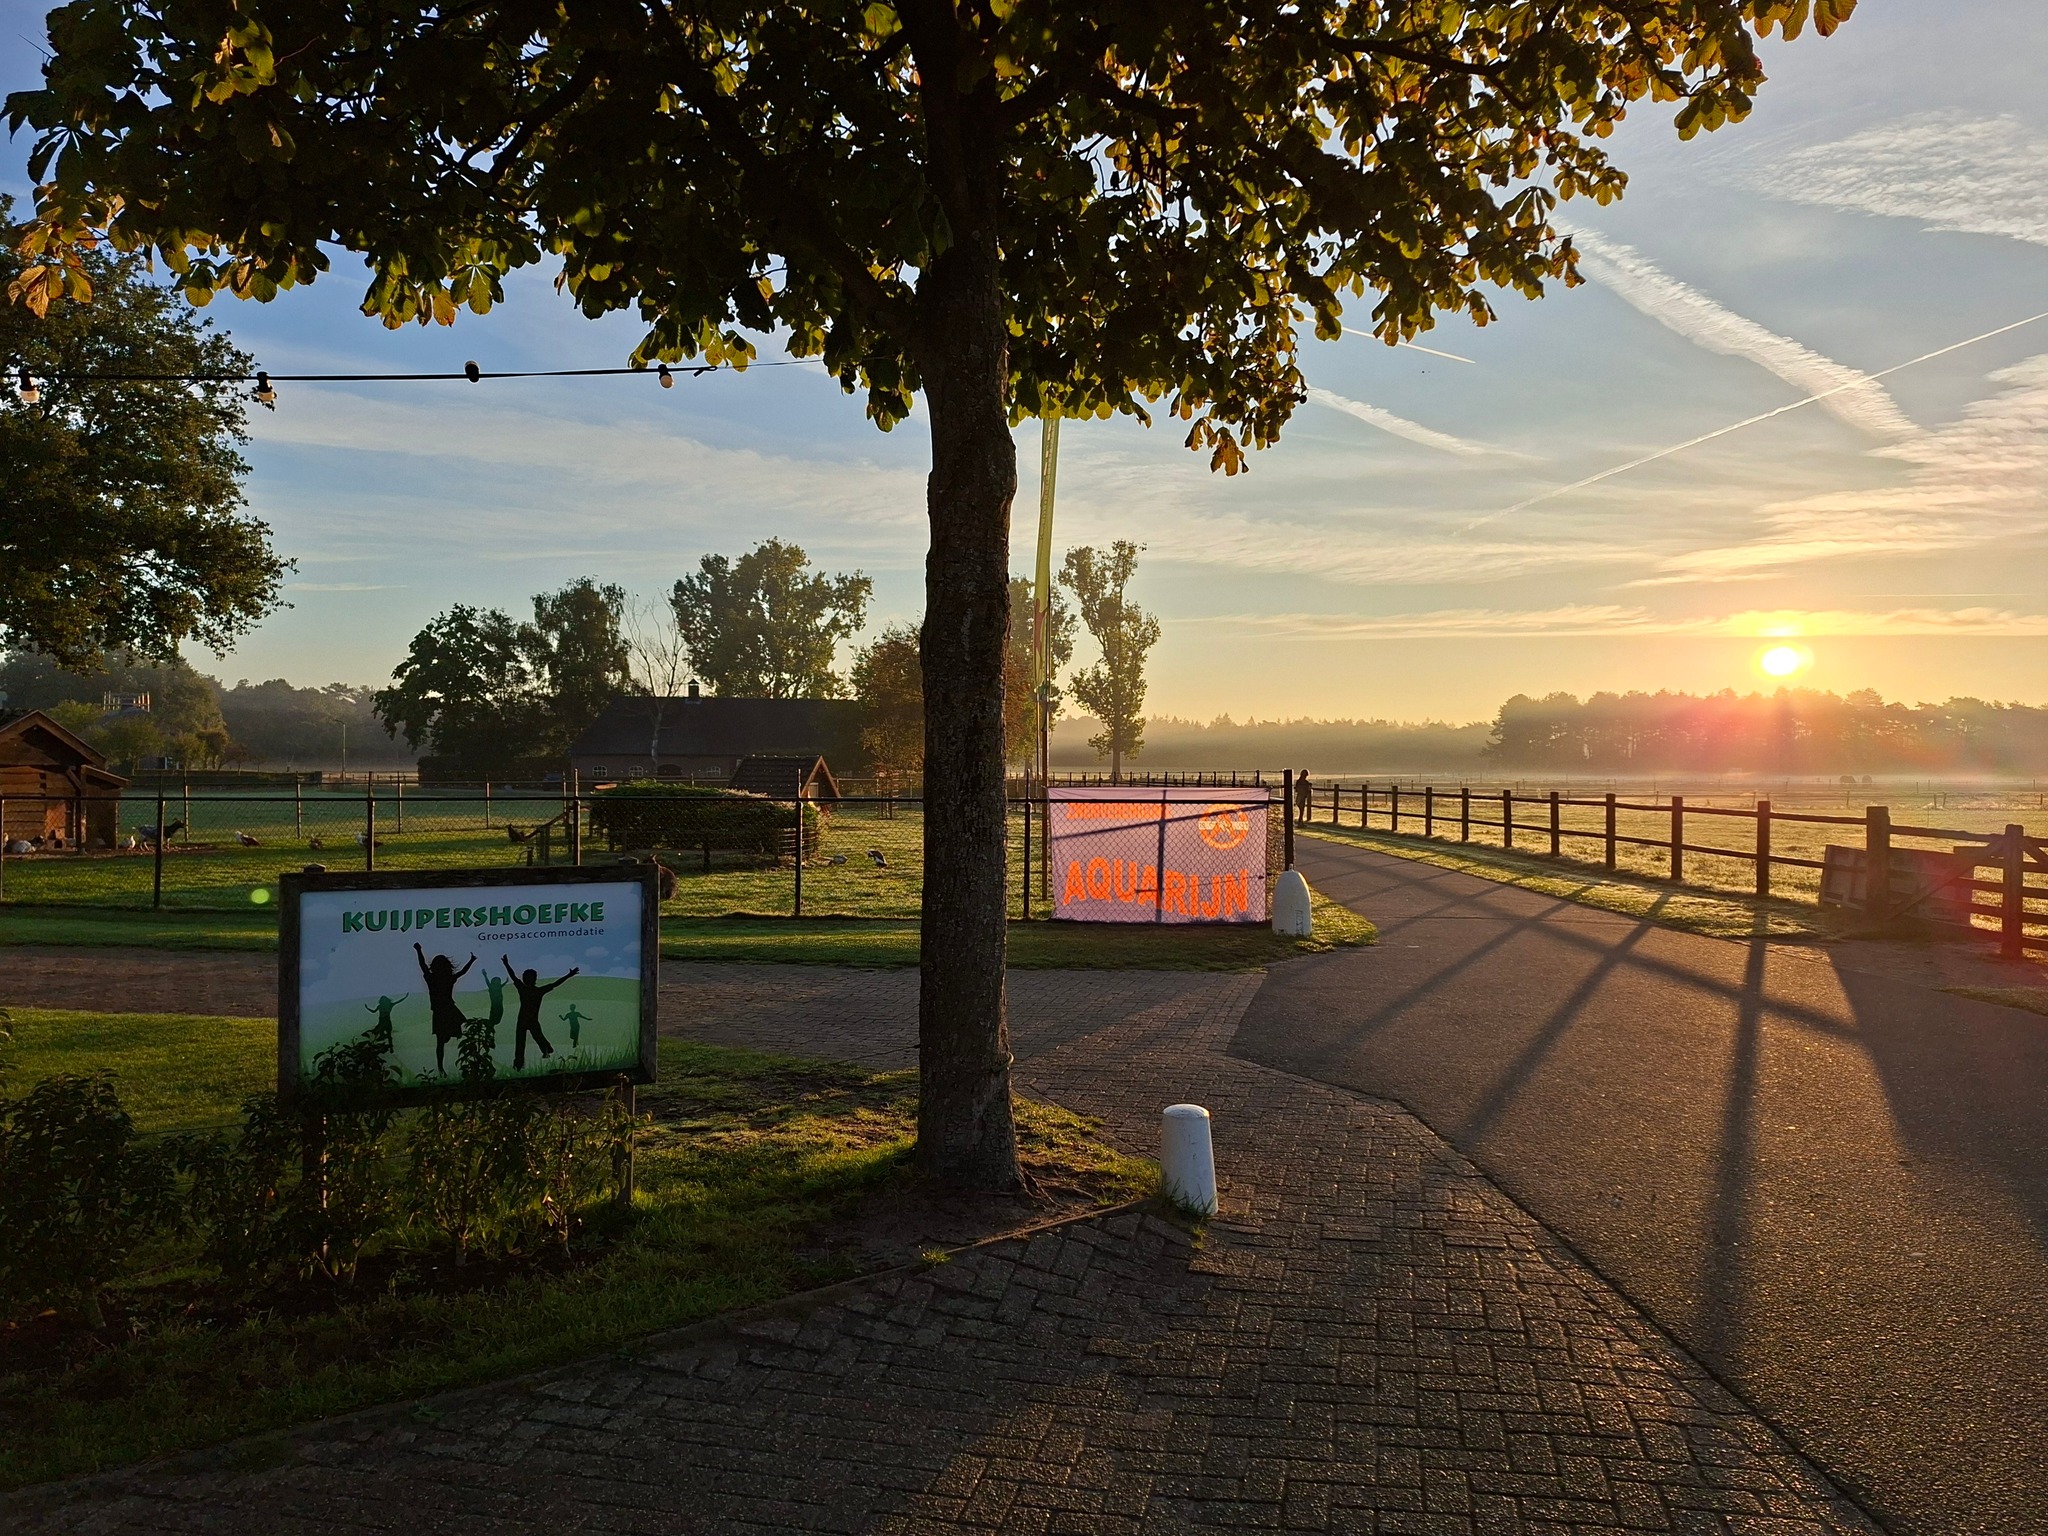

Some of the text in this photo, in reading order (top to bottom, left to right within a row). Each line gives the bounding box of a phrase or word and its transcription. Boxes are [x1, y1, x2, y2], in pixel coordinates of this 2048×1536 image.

[1063, 857, 1248, 919] AQUARIJN
[342, 901, 605, 933] KUIJPERSHOEFKE
[478, 927, 605, 941] Groepsaccommodatie
